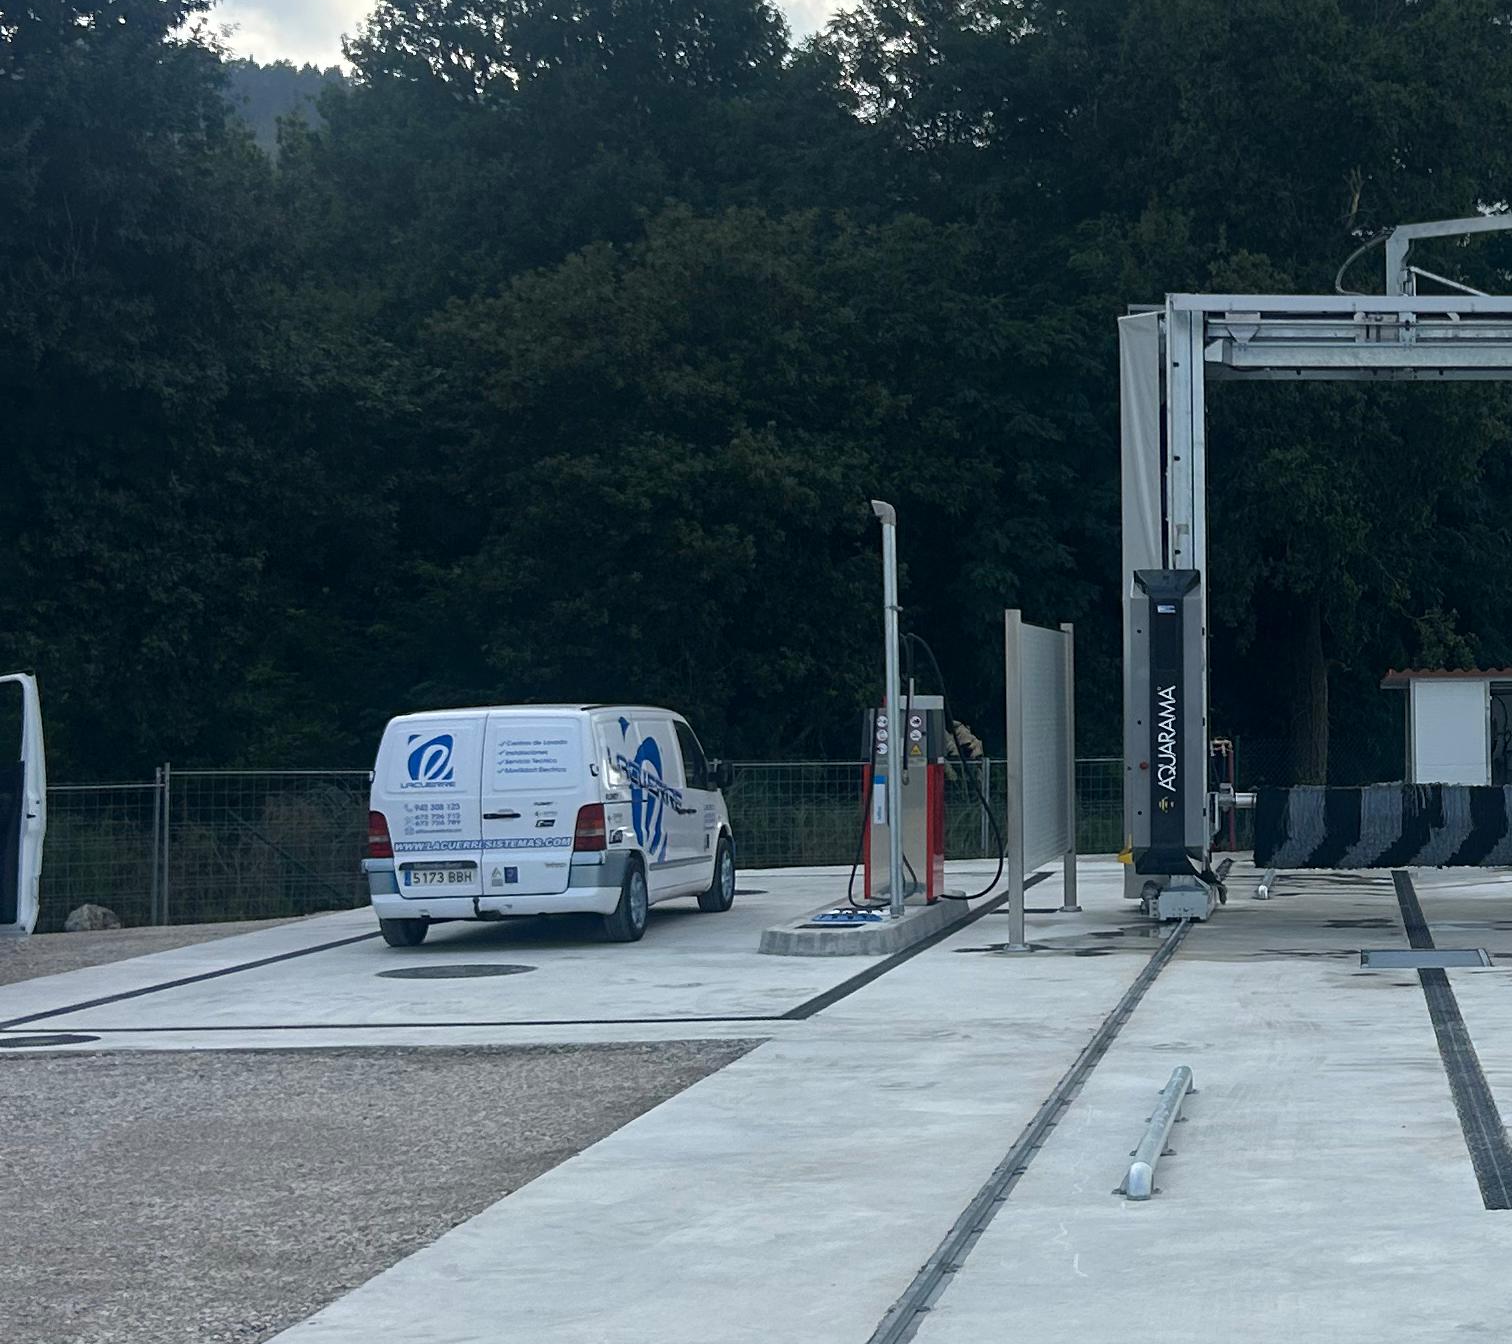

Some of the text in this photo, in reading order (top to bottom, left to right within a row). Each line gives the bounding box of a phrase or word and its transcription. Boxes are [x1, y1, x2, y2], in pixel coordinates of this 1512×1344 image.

[1157, 684, 1177, 792] AQUARAMA
[413, 871, 472, 884] 5173 BBH
